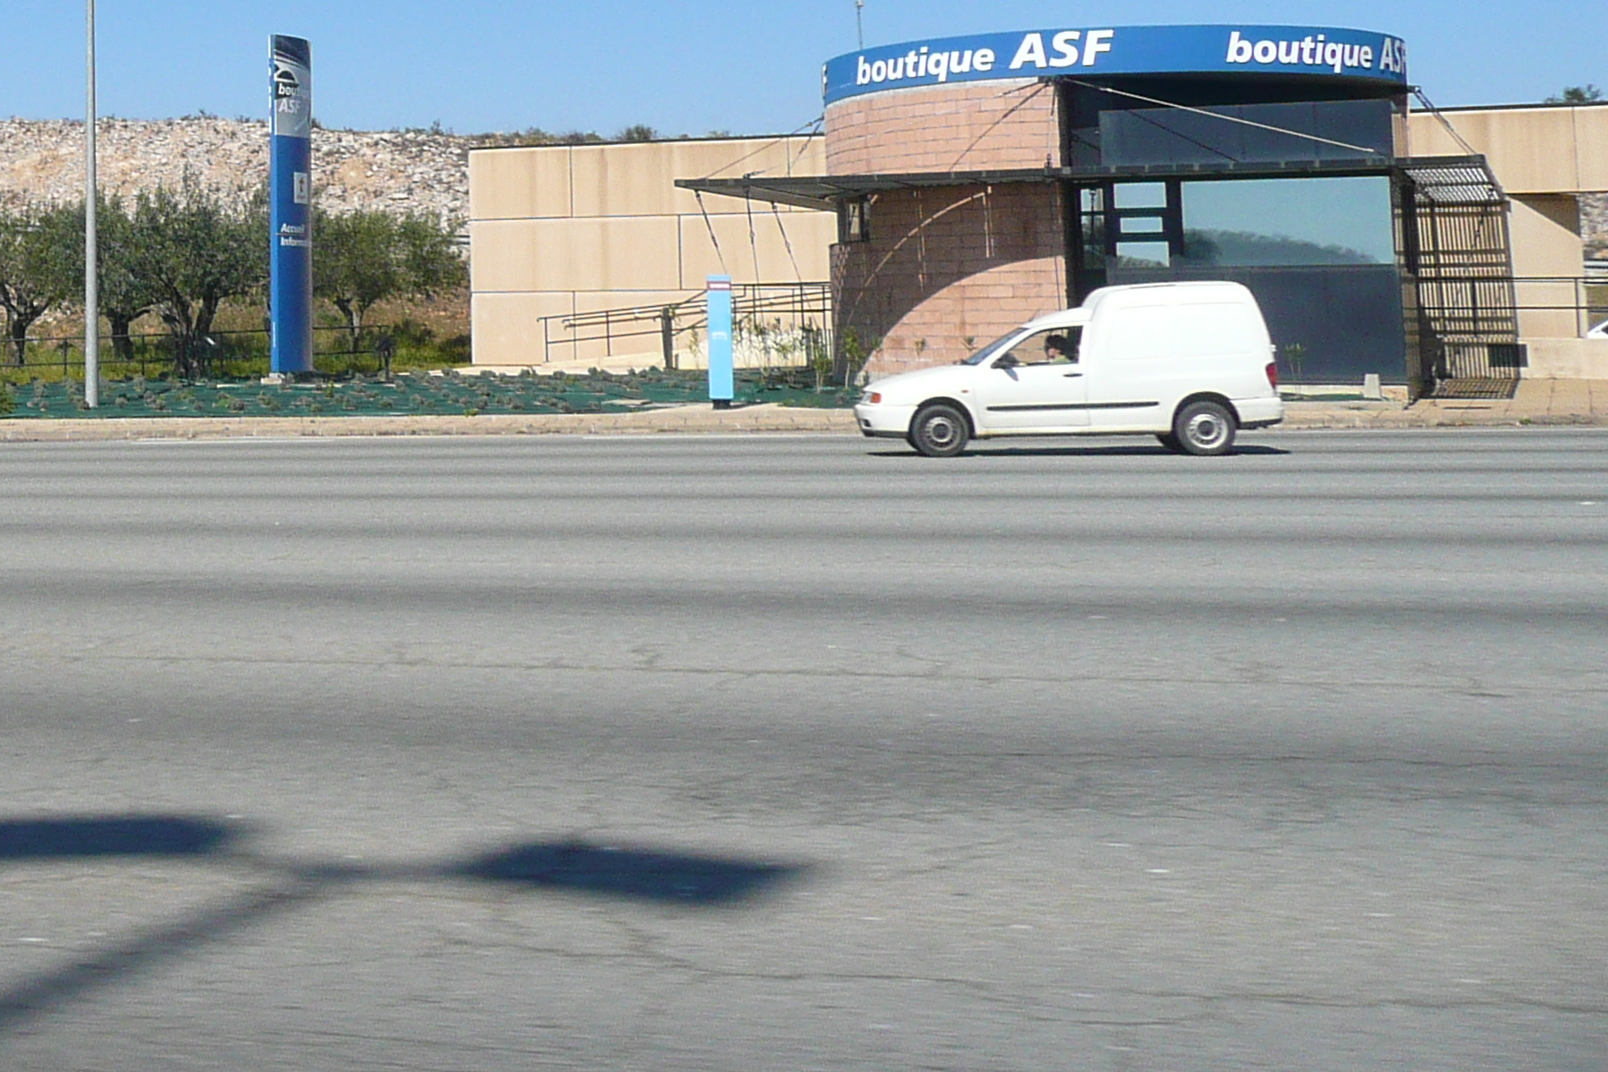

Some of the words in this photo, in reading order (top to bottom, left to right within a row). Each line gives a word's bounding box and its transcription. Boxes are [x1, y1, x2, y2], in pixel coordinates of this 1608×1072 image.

[856, 46, 995, 85] boutique
[1009, 29, 1114, 69] ASF
[1226, 31, 1372, 74] boutique
[278, 98, 301, 114] ASF
